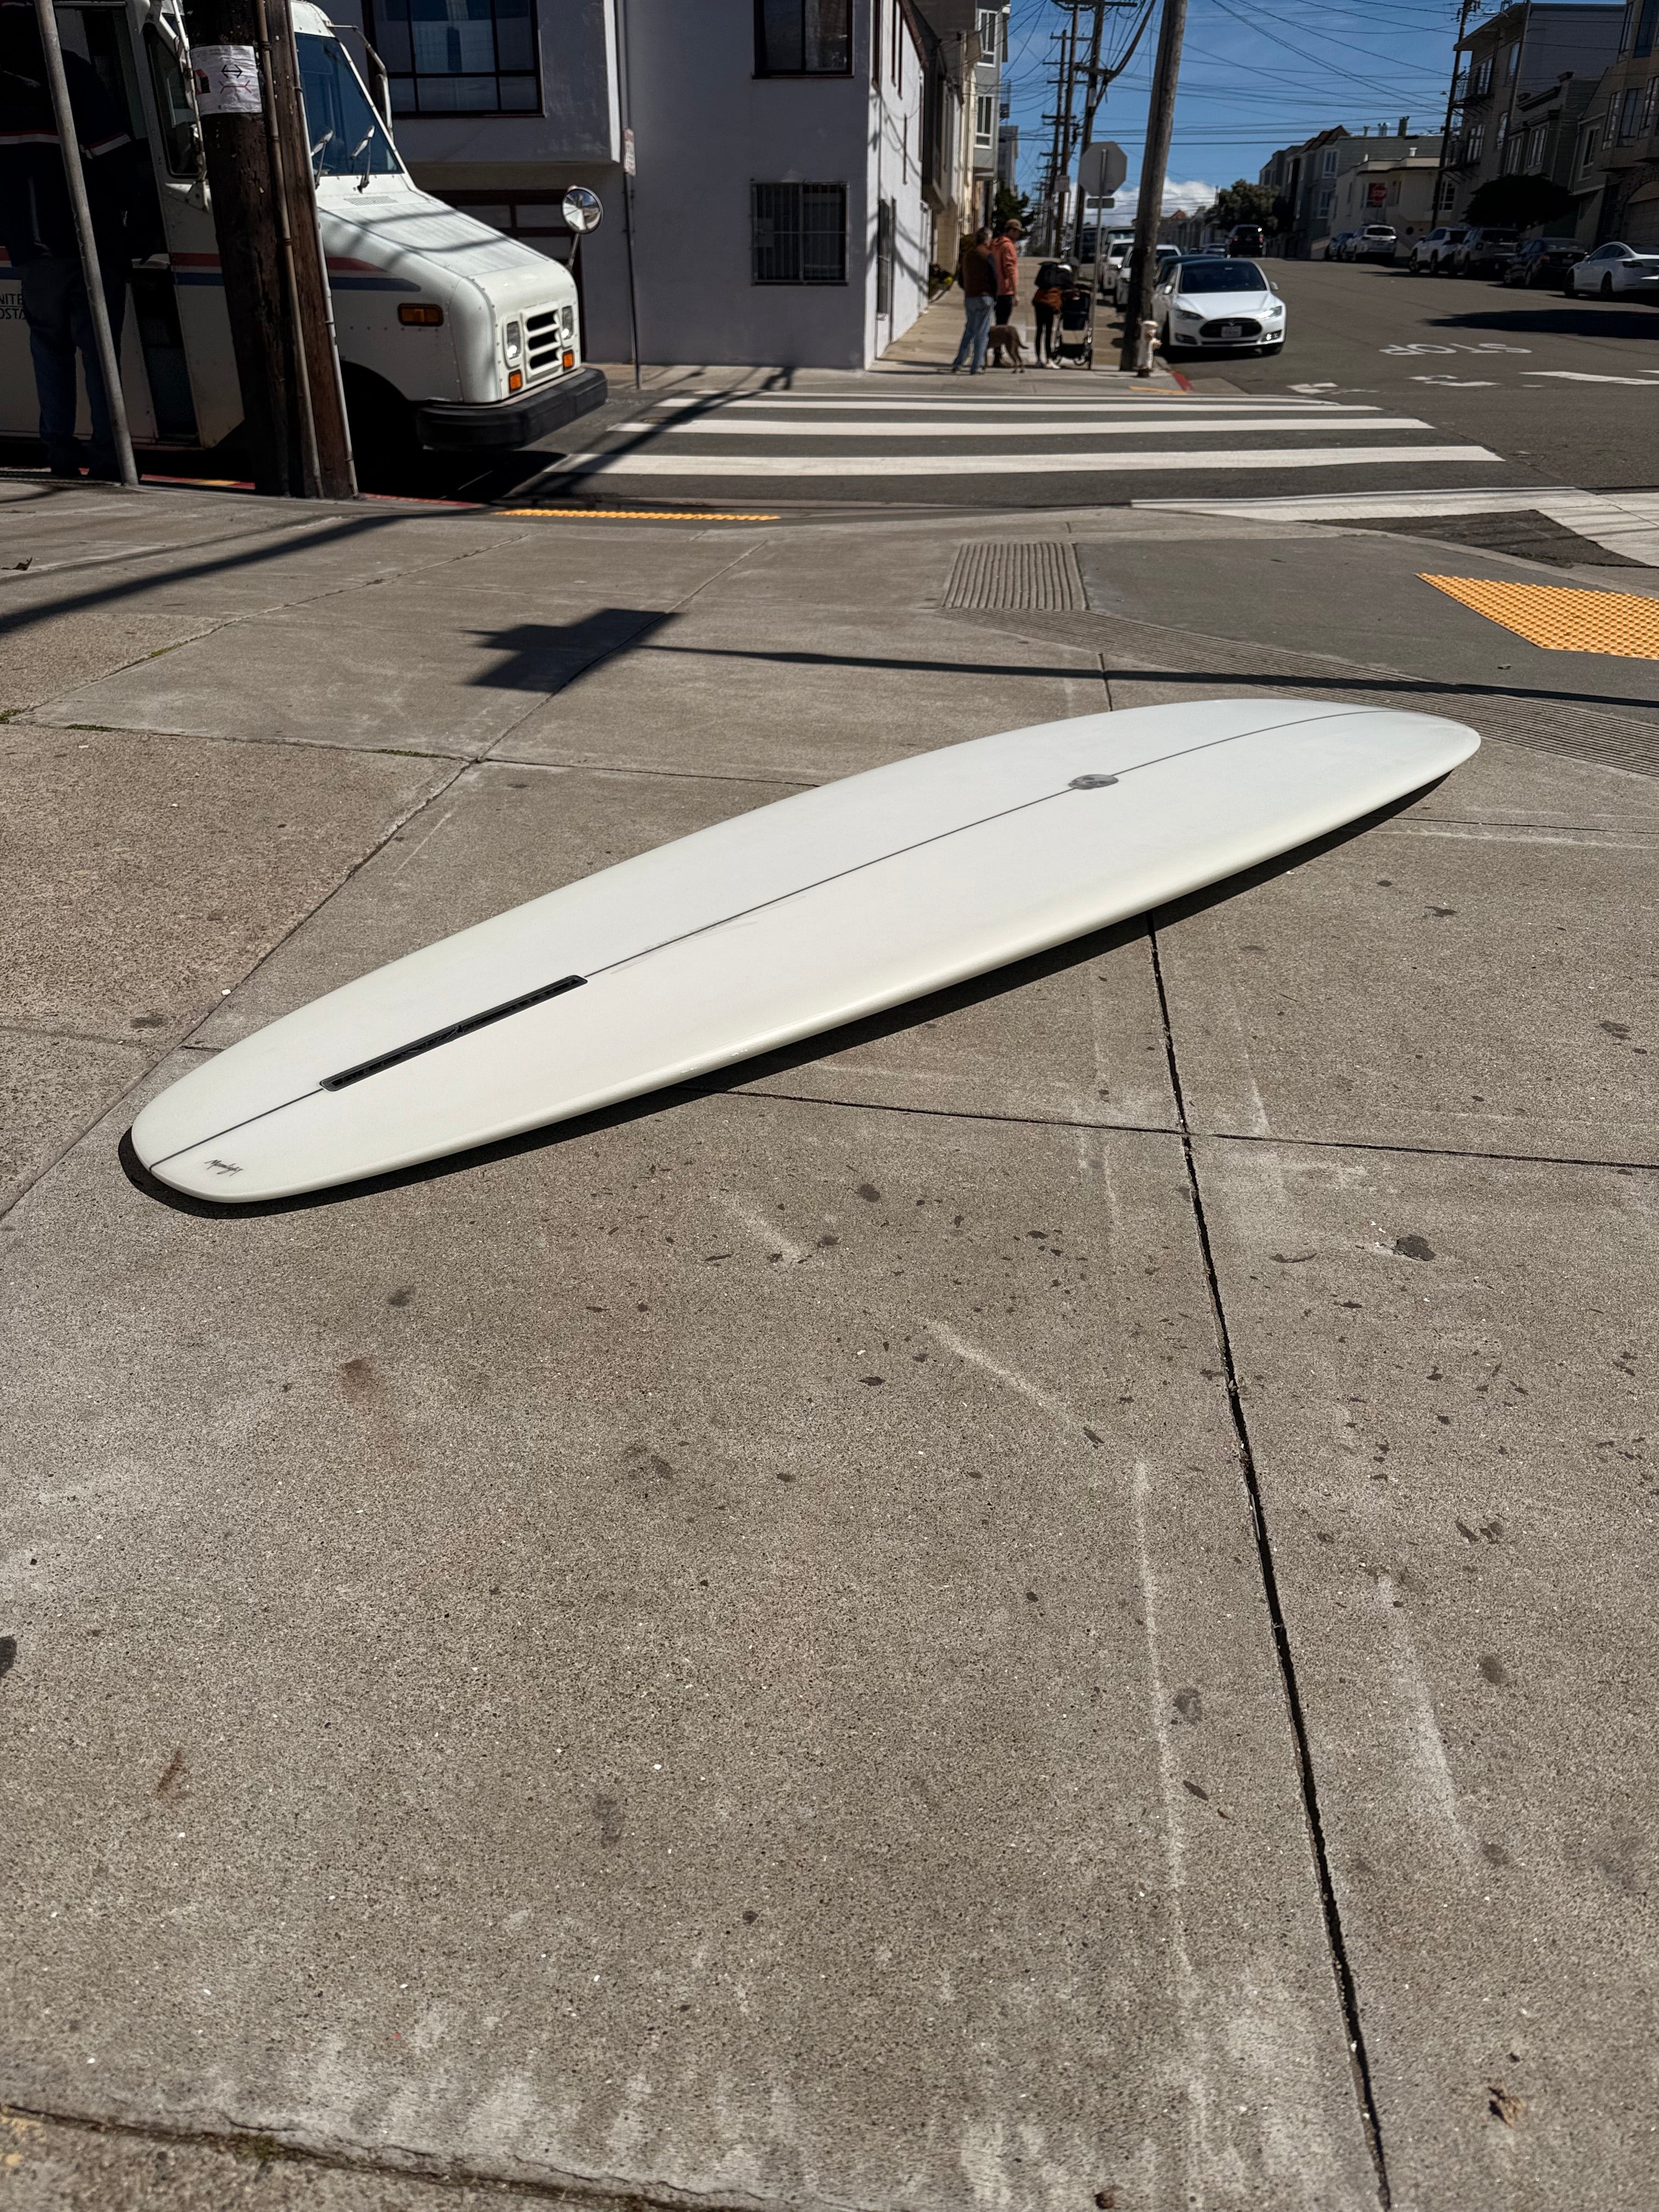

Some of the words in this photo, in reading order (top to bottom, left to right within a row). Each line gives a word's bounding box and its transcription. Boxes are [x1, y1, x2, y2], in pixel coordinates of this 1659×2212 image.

[0, 293, 22, 304] NITE
[0, 308, 26, 320] OSTA
[1378, 343, 1533, 356] STOP
